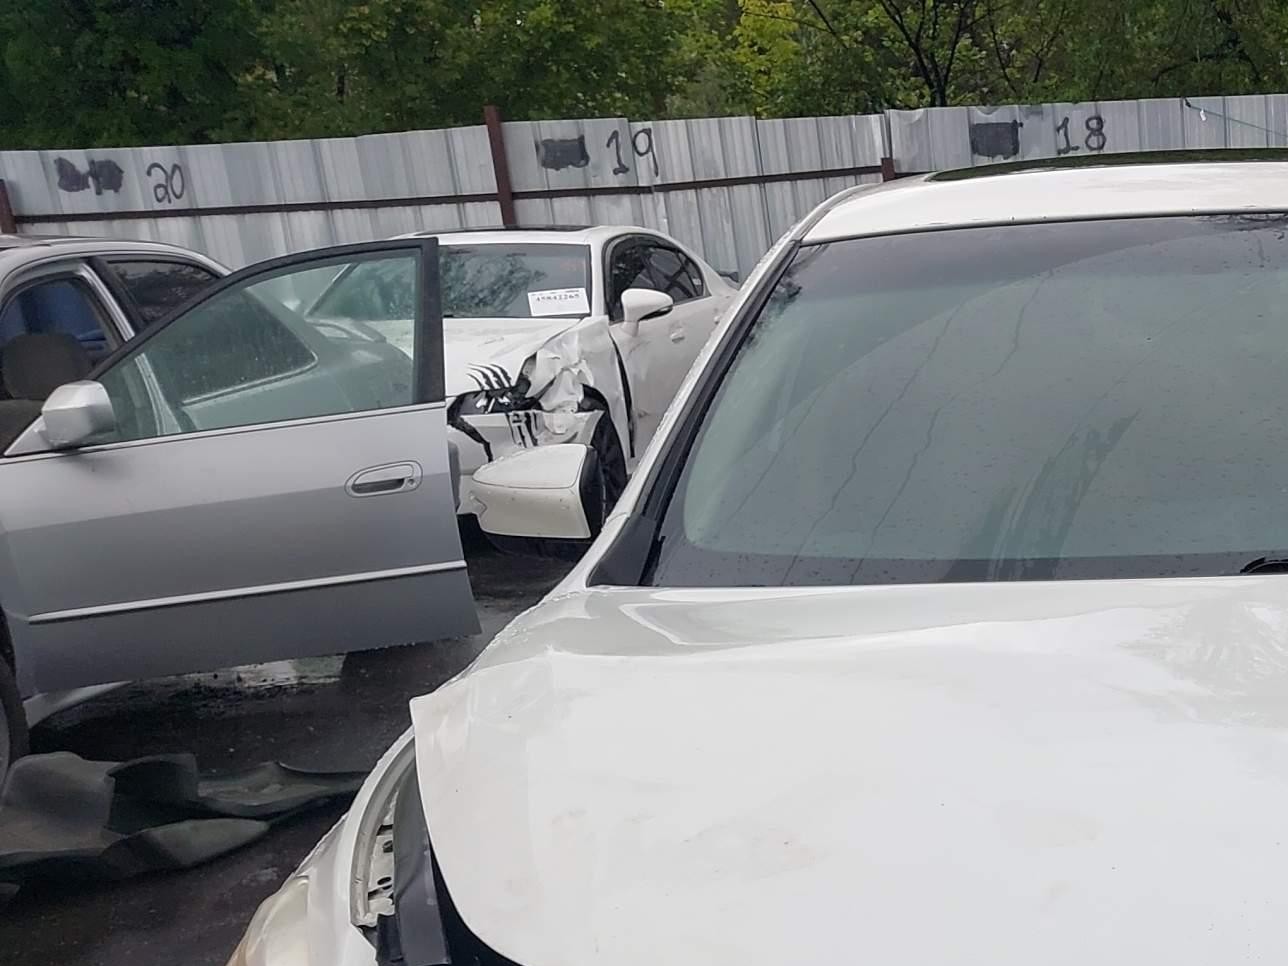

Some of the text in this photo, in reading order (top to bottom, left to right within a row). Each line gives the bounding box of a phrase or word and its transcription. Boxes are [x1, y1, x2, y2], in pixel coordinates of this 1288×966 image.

[606, 127, 659, 178] 19
[1056, 115, 1107, 155] 18
[146, 162, 185, 204] 20
